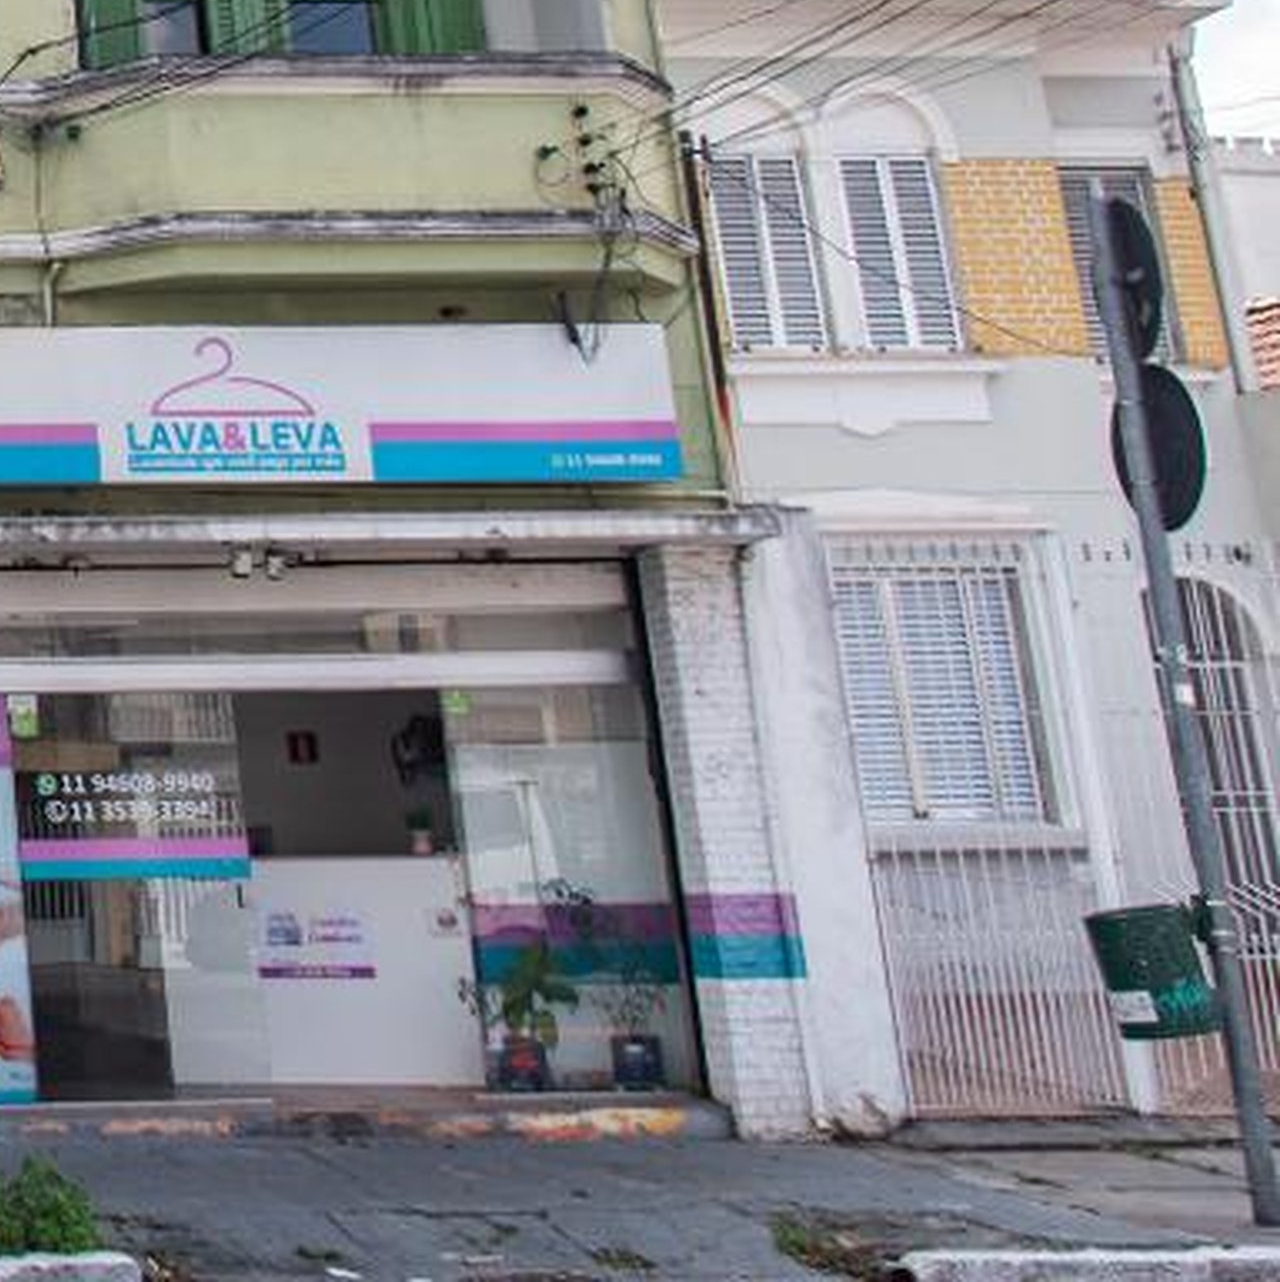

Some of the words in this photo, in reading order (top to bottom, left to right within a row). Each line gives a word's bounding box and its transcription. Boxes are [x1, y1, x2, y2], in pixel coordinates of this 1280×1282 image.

[126, 421, 343, 451] LAVA&LEVA
[62, 773, 86, 794] 11
[70, 801, 96, 823] 11
